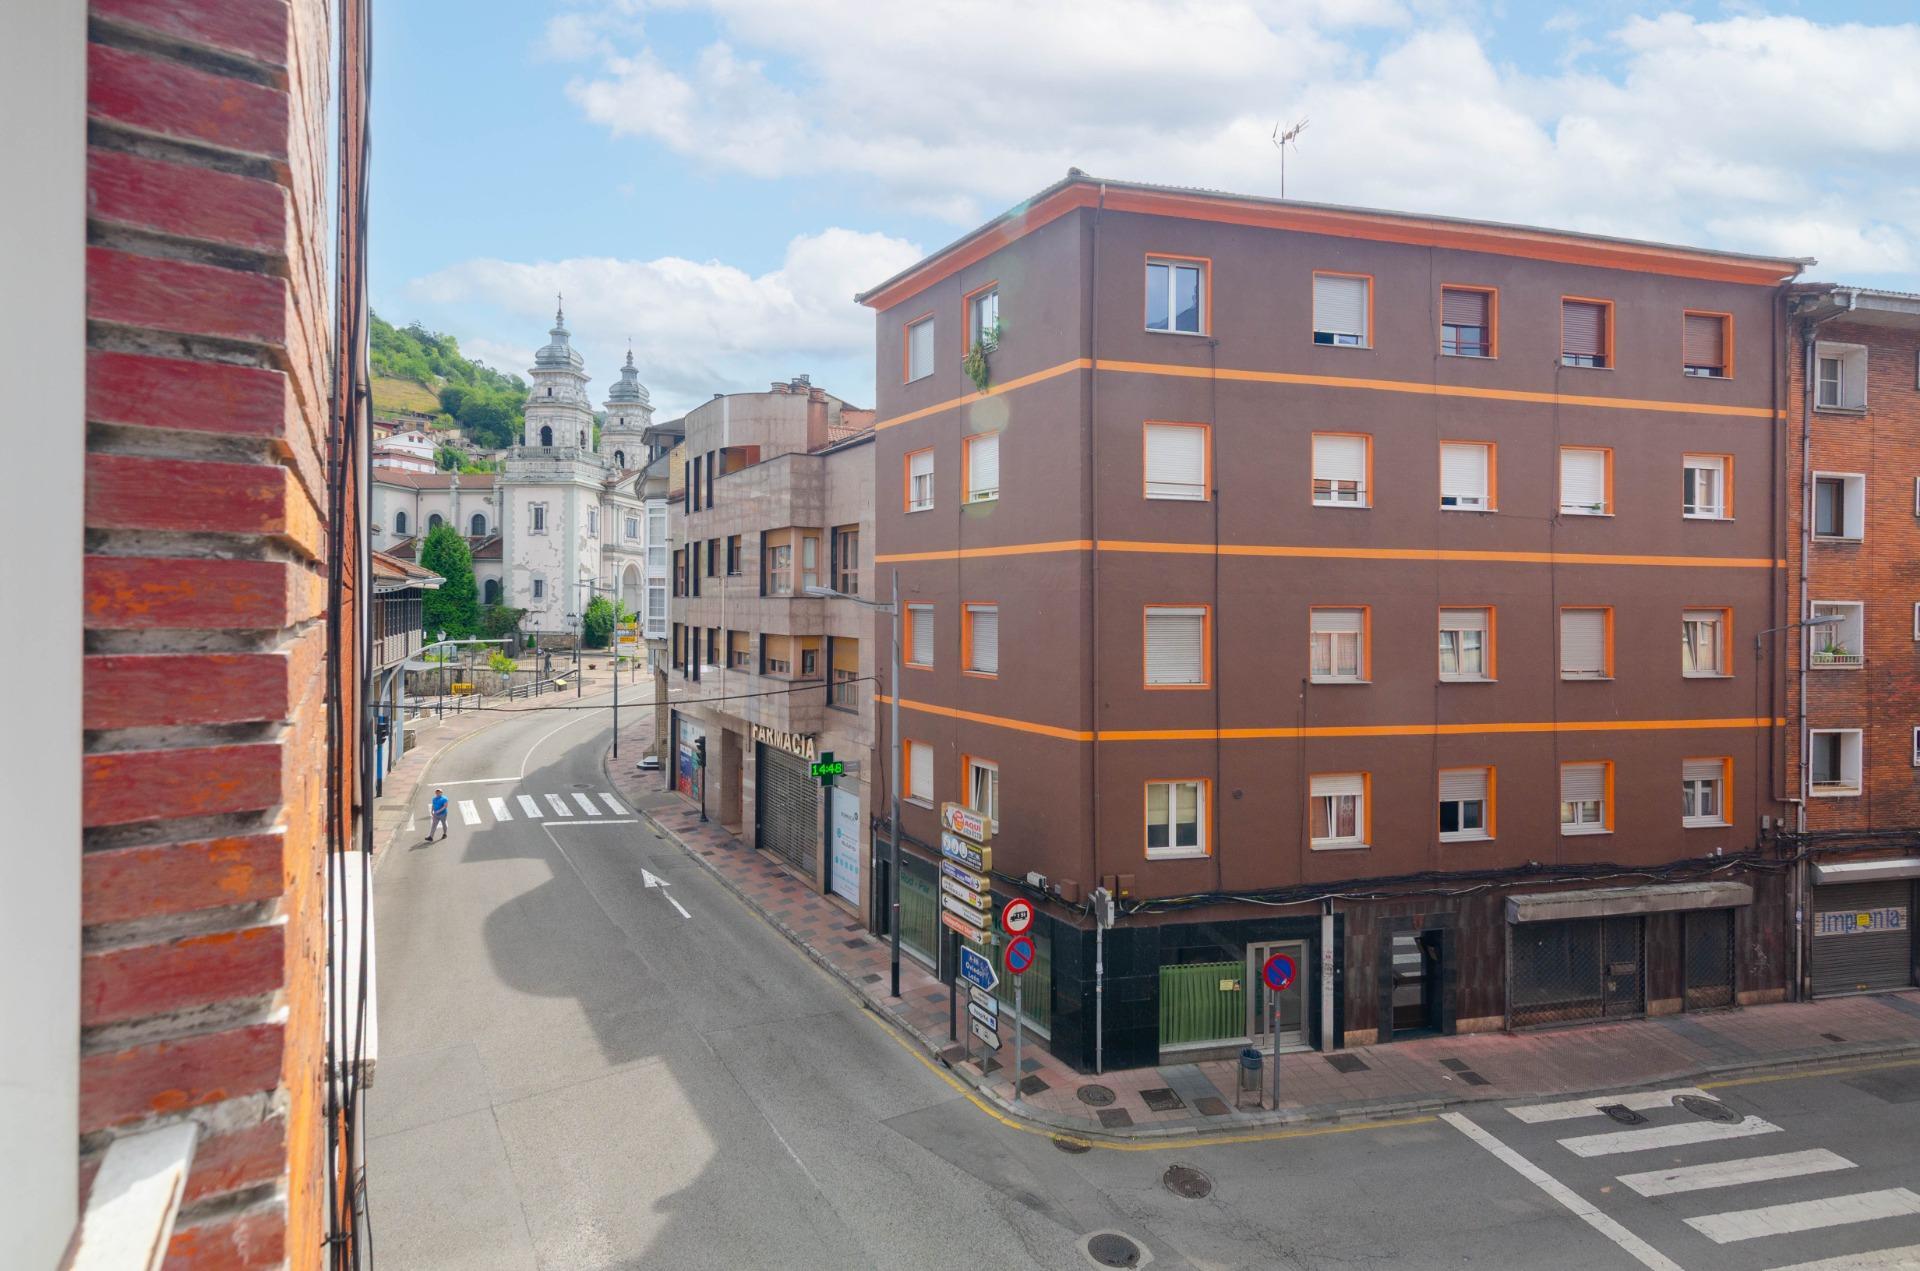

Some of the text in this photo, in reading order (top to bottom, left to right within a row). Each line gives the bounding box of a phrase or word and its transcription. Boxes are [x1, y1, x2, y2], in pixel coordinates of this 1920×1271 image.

[752, 724, 815, 761] FARMACIA
[812, 763, 843, 776] 14:48
[1822, 908, 1900, 934] Impnta
